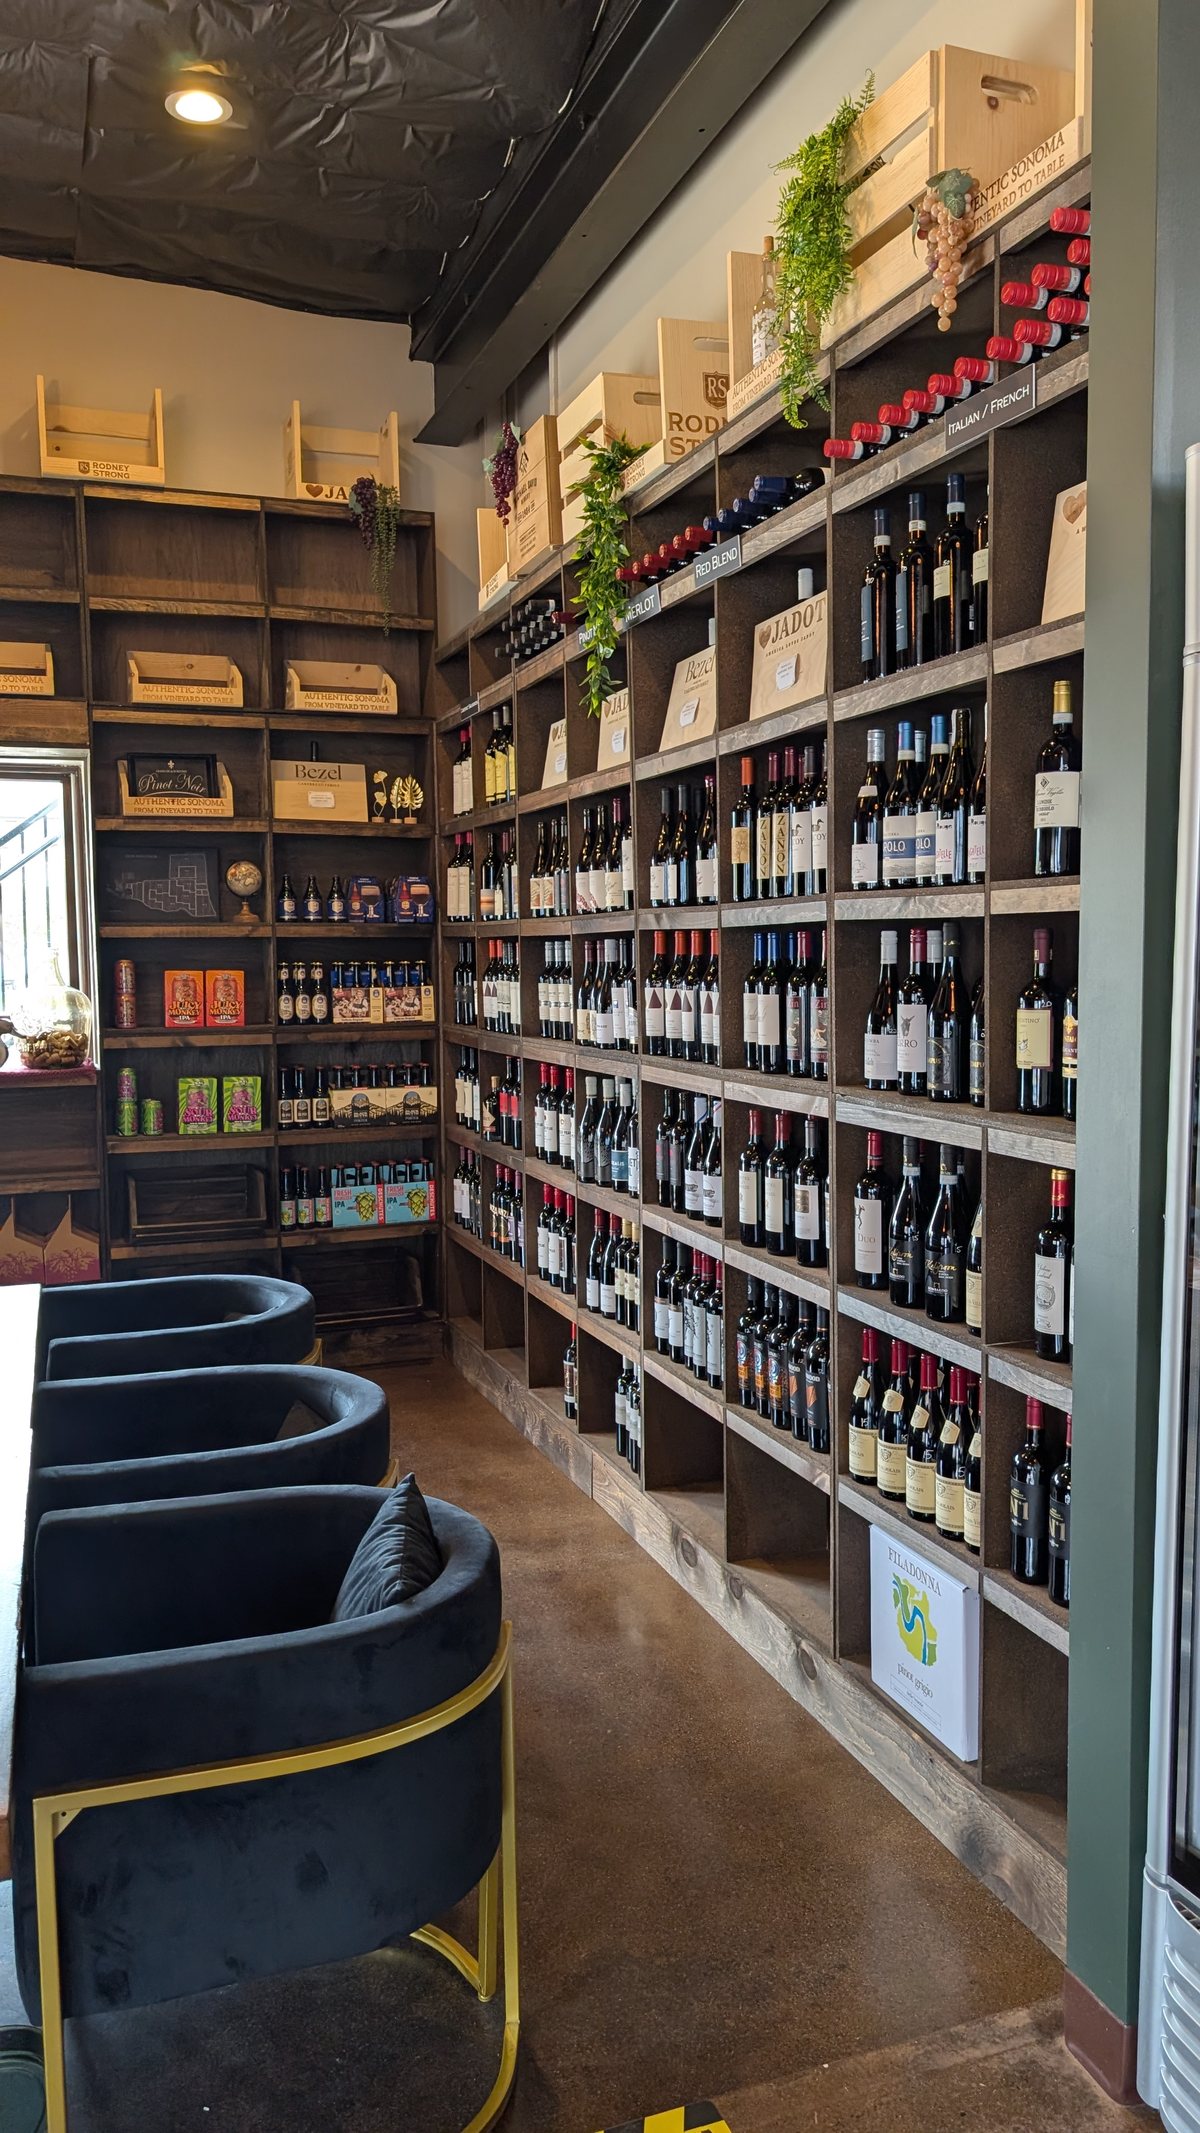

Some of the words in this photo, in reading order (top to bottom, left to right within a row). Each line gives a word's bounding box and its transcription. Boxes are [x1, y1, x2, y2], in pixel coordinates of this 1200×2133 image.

[972, 172, 1009, 212] ENTIC
[1011, 131, 1065, 183] SONOMA
[1018, 179, 1032, 197] TO
[1034, 154, 1065, 186] TABLE
[708, 377, 727, 399] RS
[948, 410, 980, 436] ITALIAN
[990, 384, 1030, 414] FRENCH
[668, 411, 729, 433] ROD
[92, 462, 130, 472] RODNEY
[93, 470, 130, 479] STRONG
[695, 561, 711, 578] RED
[712, 548, 738, 571] BLEND
[625, 595, 655, 623] MERLOT
[771, 598, 827, 644] JADOT
[3, 675, 44, 684] SONOMA
[142, 685, 195, 694] AUTHENTIC
[196, 687, 234, 695] SONOMA
[304, 693, 353, 701] AUTHENTIC
[354, 695, 390, 703] SONOMA
[371, 704, 390, 712] TABLE
[611, 692, 629, 715] JAD
[295, 764, 343, 780] Bezel
[138, 773, 173, 793] Pinot
[174, 773, 209, 794] Noir
[133, 798, 186, 806] AUTHENTIC
[187, 798, 225, 807] SONOMA
[777, 815, 786, 874] ZANON
[169, 1000, 202, 1009] JUICY
[210, 1000, 243, 1009] JUICY
[334, 1200, 346, 1208] IPA
[923, 1449, 934, 1460] 15
[888, 1546, 942, 1597] FILADONNA
[897, 1662, 914, 1683] pinot
[915, 1678, 934, 1698] grigio
